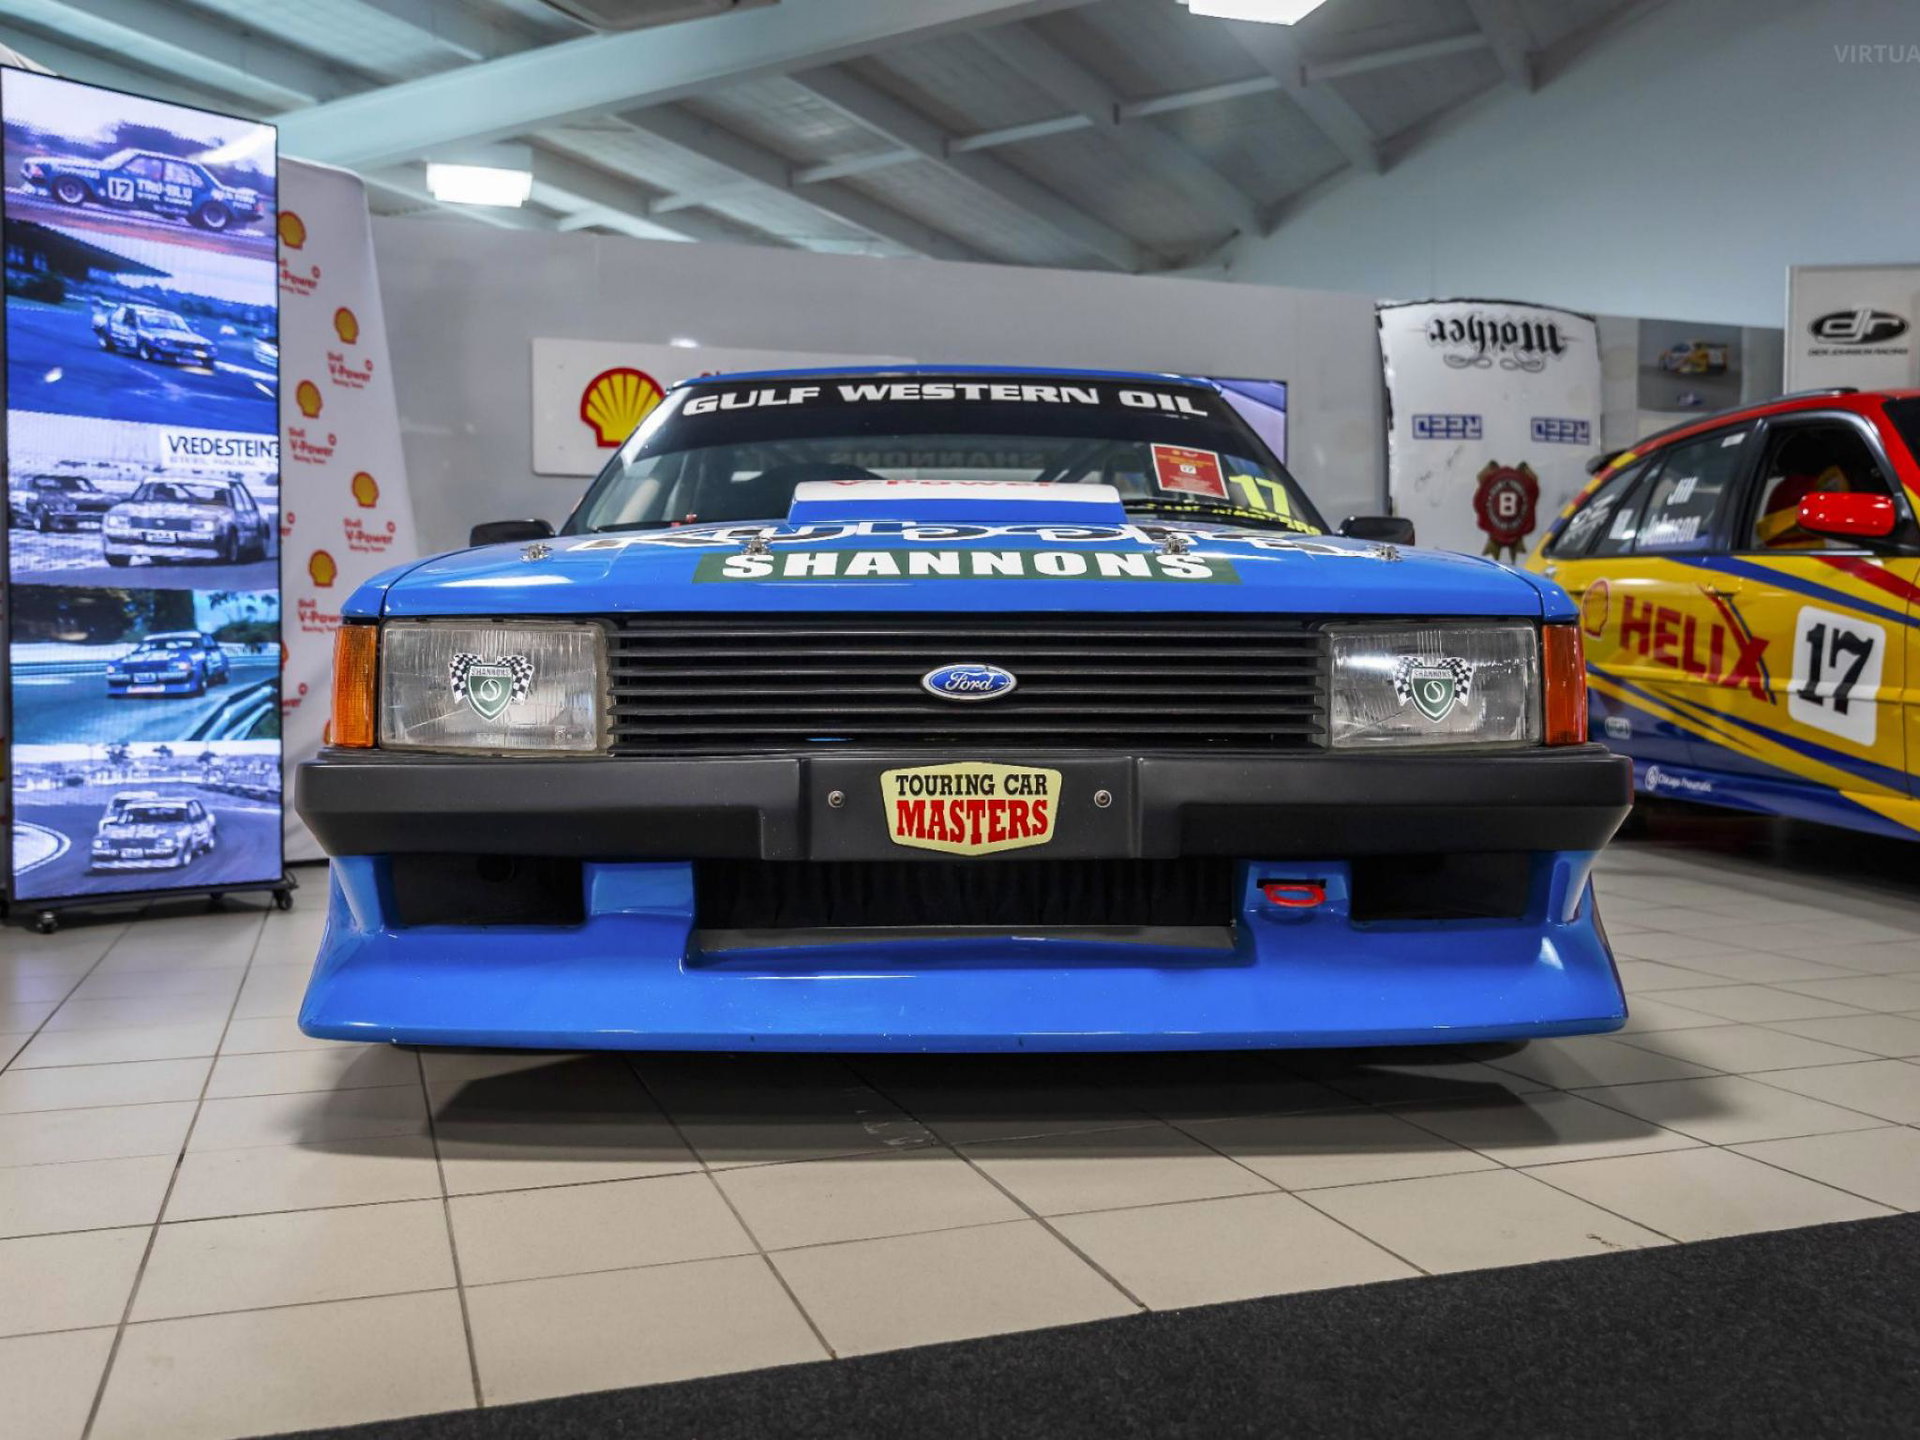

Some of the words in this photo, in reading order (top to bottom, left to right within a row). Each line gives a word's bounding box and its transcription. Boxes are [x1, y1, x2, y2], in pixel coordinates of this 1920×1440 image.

[682, 386, 821, 416] GULF
[838, 384, 1099, 405] WESTERN
[1118, 390, 1208, 417] OIL
[1228, 474, 1291, 516] 17
[721, 551, 1214, 579] SHANNONS
[1620, 587, 1771, 702] HELIX
[945, 671, 1001, 691] Ford
[1797, 622, 1875, 716] 17
[896, 774, 996, 796] TOURING
[1004, 774, 1048, 796] CAR
[896, 799, 1049, 845] MASTERS
